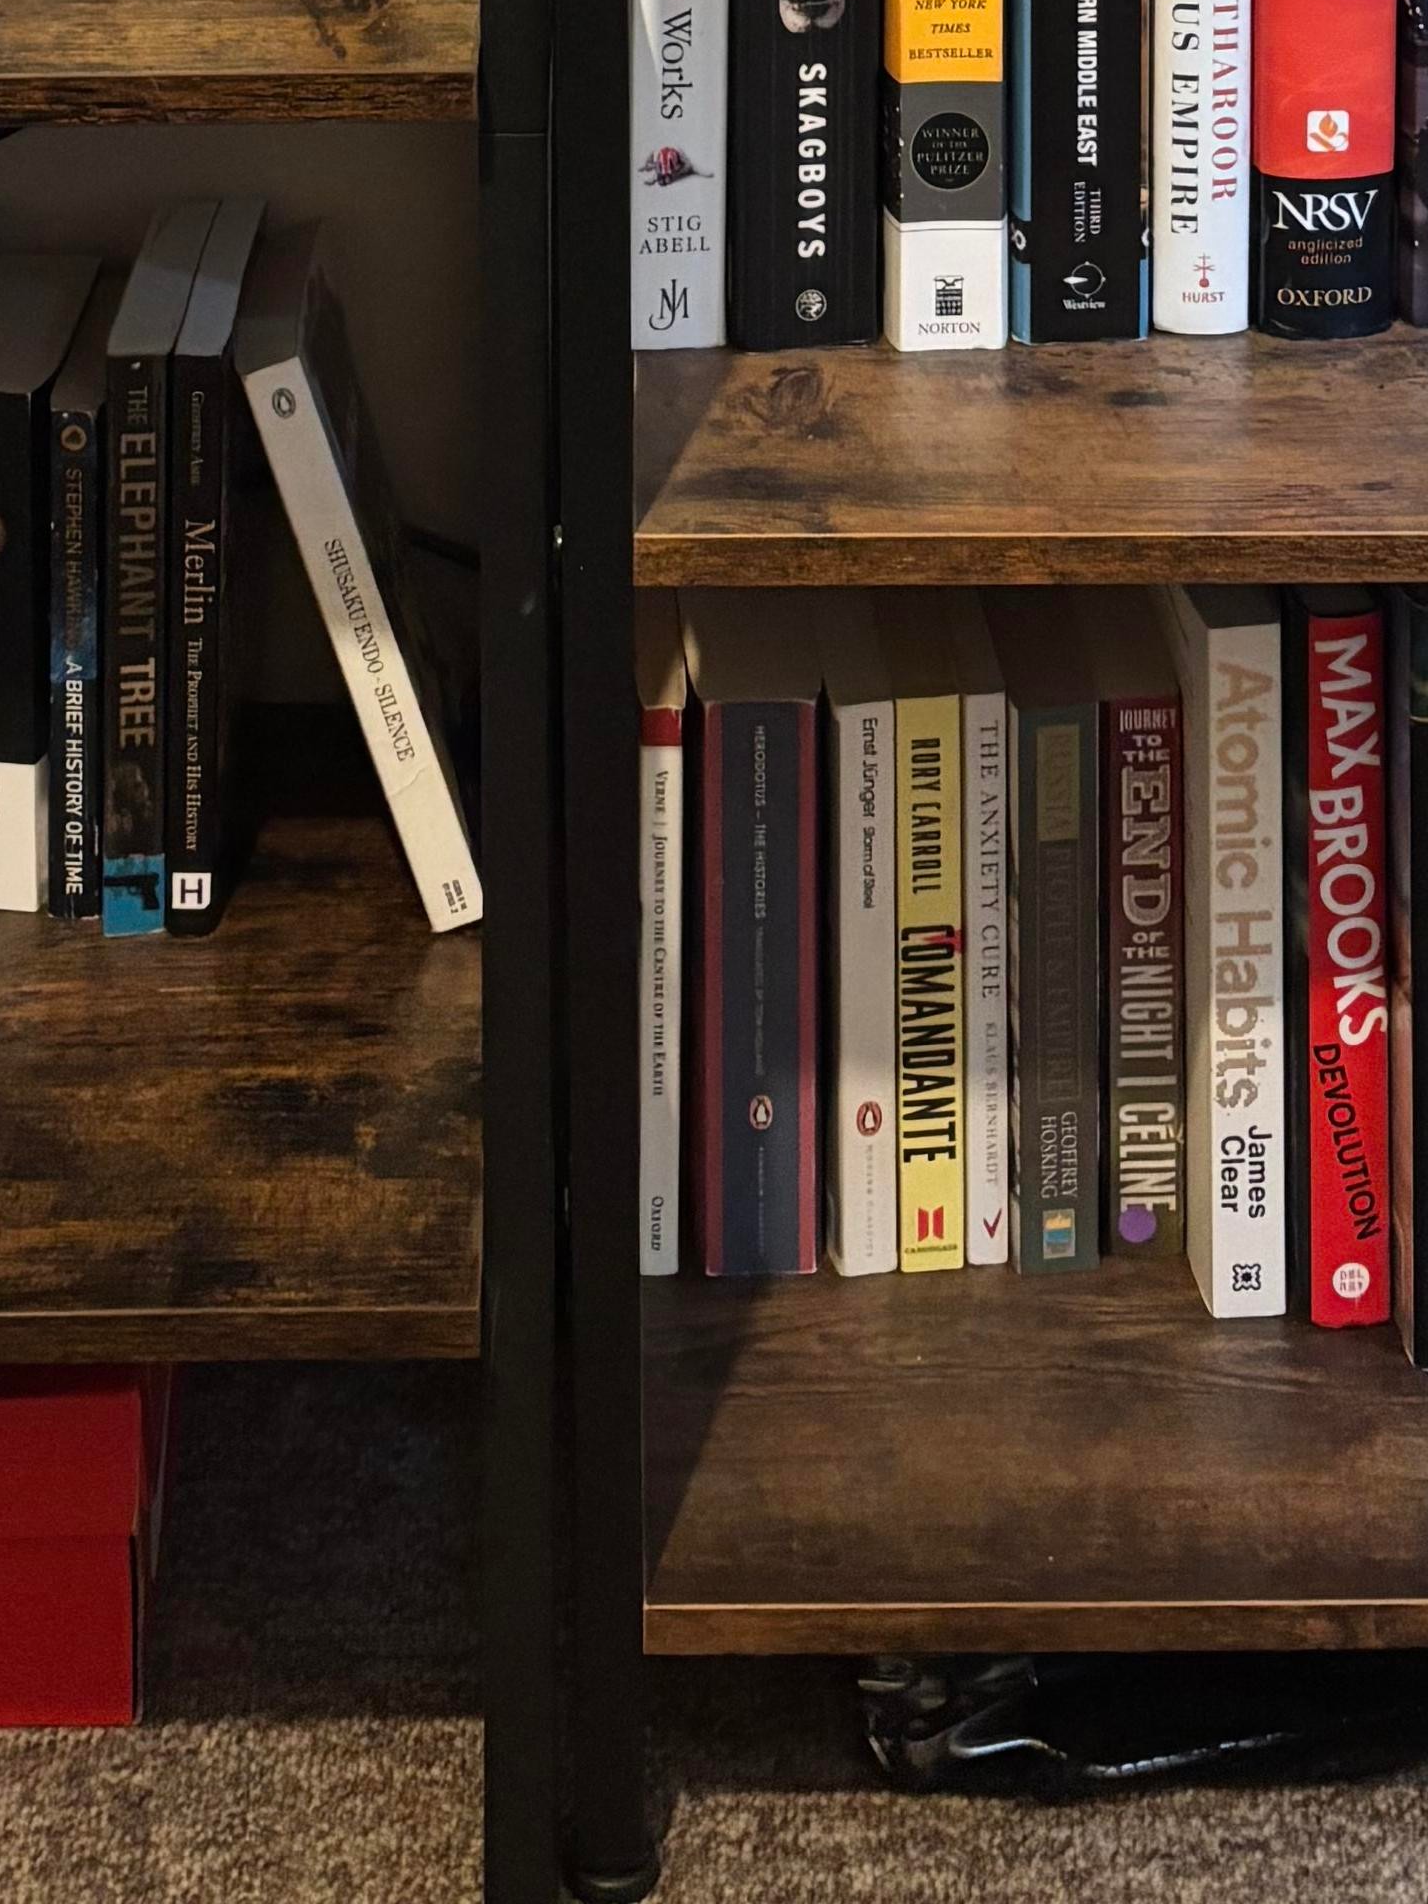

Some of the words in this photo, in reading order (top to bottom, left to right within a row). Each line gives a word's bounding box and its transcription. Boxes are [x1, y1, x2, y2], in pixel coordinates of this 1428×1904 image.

[797, 63, 828, 259] SKAGBOYS
[1273, 191, 1378, 232] NRSV
[918, 320, 981, 335] NORTON
[1278, 284, 1372, 308] OXFORD
[127, 387, 148, 425] THE
[119, 432, 155, 651] ELEPHANT
[352, 621, 381, 675] ENDO
[119, 660, 154, 749] TREE
[374, 683, 415, 762] SILENCE
[1314, 634, 1381, 778] MAX
[911, 738, 940, 792] RORY
[911, 803, 941, 896] CARROLL
[1309, 788, 1389, 1046] BROOKS
[899, 925, 956, 1164] COMANDANTE
[1220, 1134, 1238, 1213] Clear
[1248, 1126, 1266, 1219] James
[1312, 1043, 1381, 1240] DEVOLUTION
